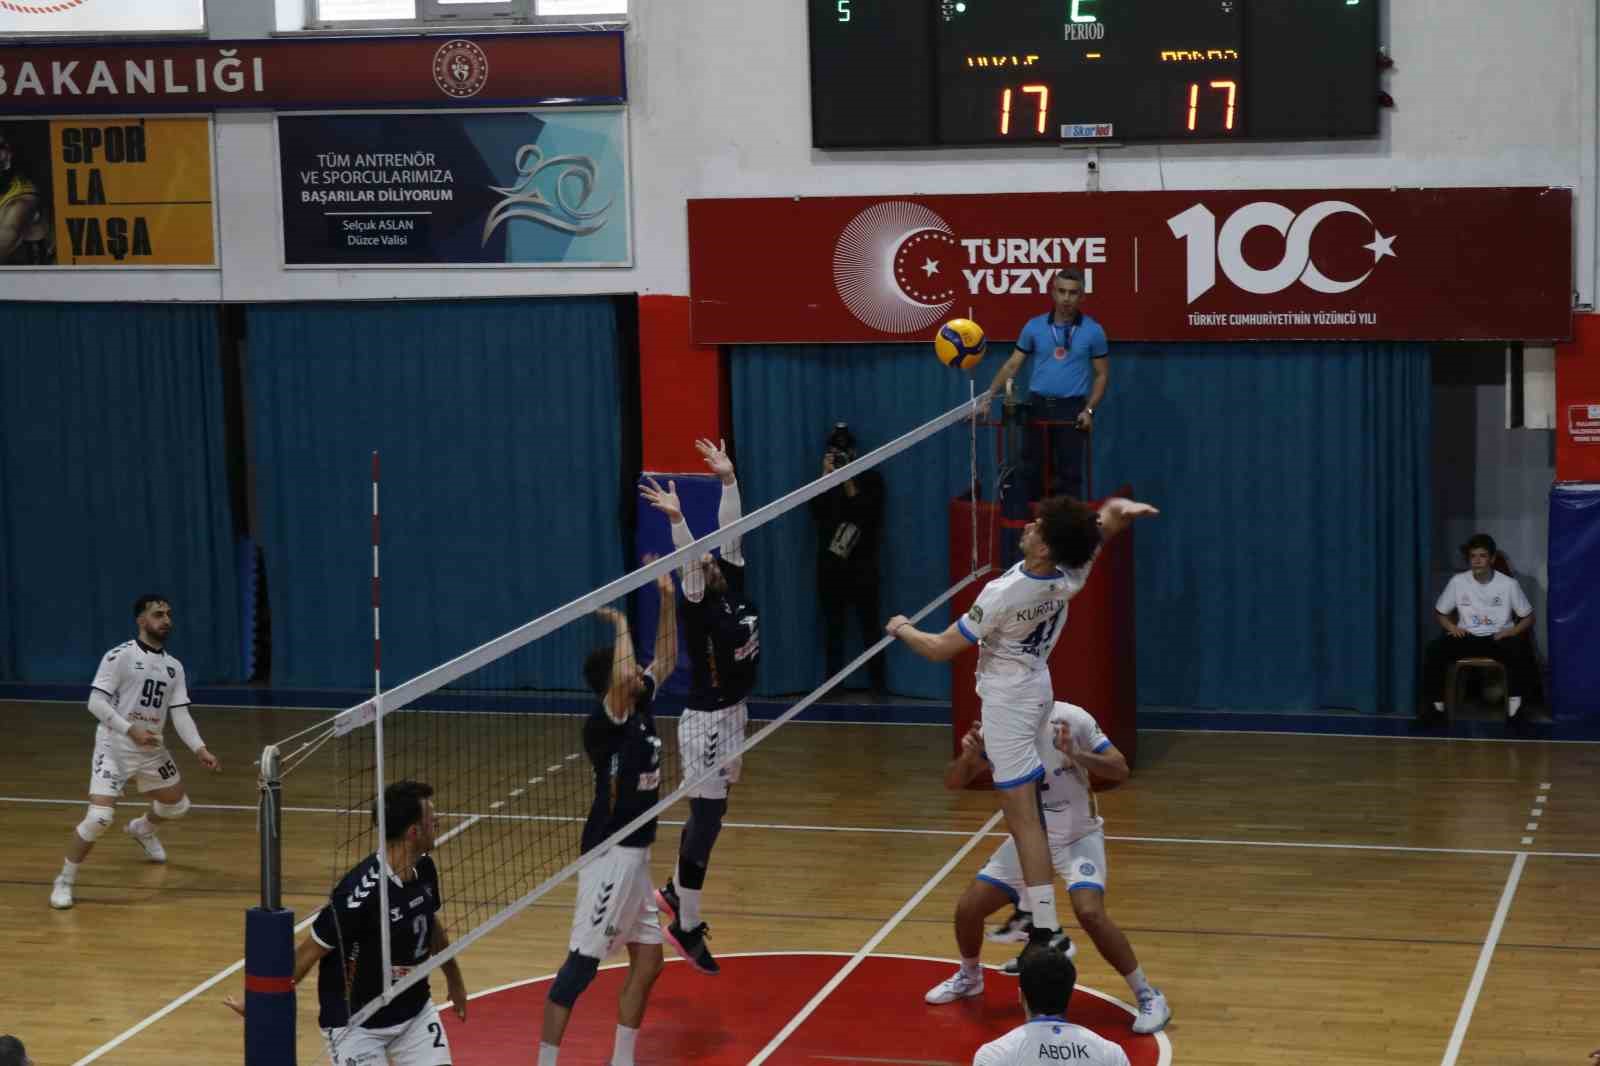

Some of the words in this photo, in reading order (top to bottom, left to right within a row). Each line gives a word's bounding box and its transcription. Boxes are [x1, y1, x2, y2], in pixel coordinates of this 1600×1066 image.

[1064, 23, 1104, 40] PERIOD
[0, 49, 265, 96] AKANLIĞI
[1001, 86, 1048, 134] 17
[1188, 82, 1236, 130] 17
[62, 126, 146, 164] SPOR
[317, 152, 350, 168] TÜM
[355, 151, 436, 167] ANTRENÖR
[67, 169, 107, 205] LA
[300, 171, 319, 184] VE
[322, 169, 454, 184] SPORCULARIMIZA
[301, 189, 375, 205] BAŞARILAR
[378, 187, 454, 202] DİLİYORUM
[65, 217, 152, 260] YAŞA
[343, 220, 377, 232] Selçuk
[378, 220, 415, 231] ASLAN
[347, 235, 380, 246] Düzce
[380, 234, 408, 245] Valisi
[961, 238, 1106, 264] TÜRKİYE
[1167, 200, 1375, 305] 100
[961, 268, 1093, 294] YÜZYI
[1187, 312, 1227, 326] TÜRKİYE
[1229, 311, 1311, 326] CUMHURİYETİ'NİN
[1312, 310, 1357, 325] YÜZÜNCÜ
[1358, 311, 1377, 325] YILI
[140, 679, 167, 709] 95
[428, 1022, 445, 1048] 2
[1038, 1042, 1090, 1060] ABDİK
